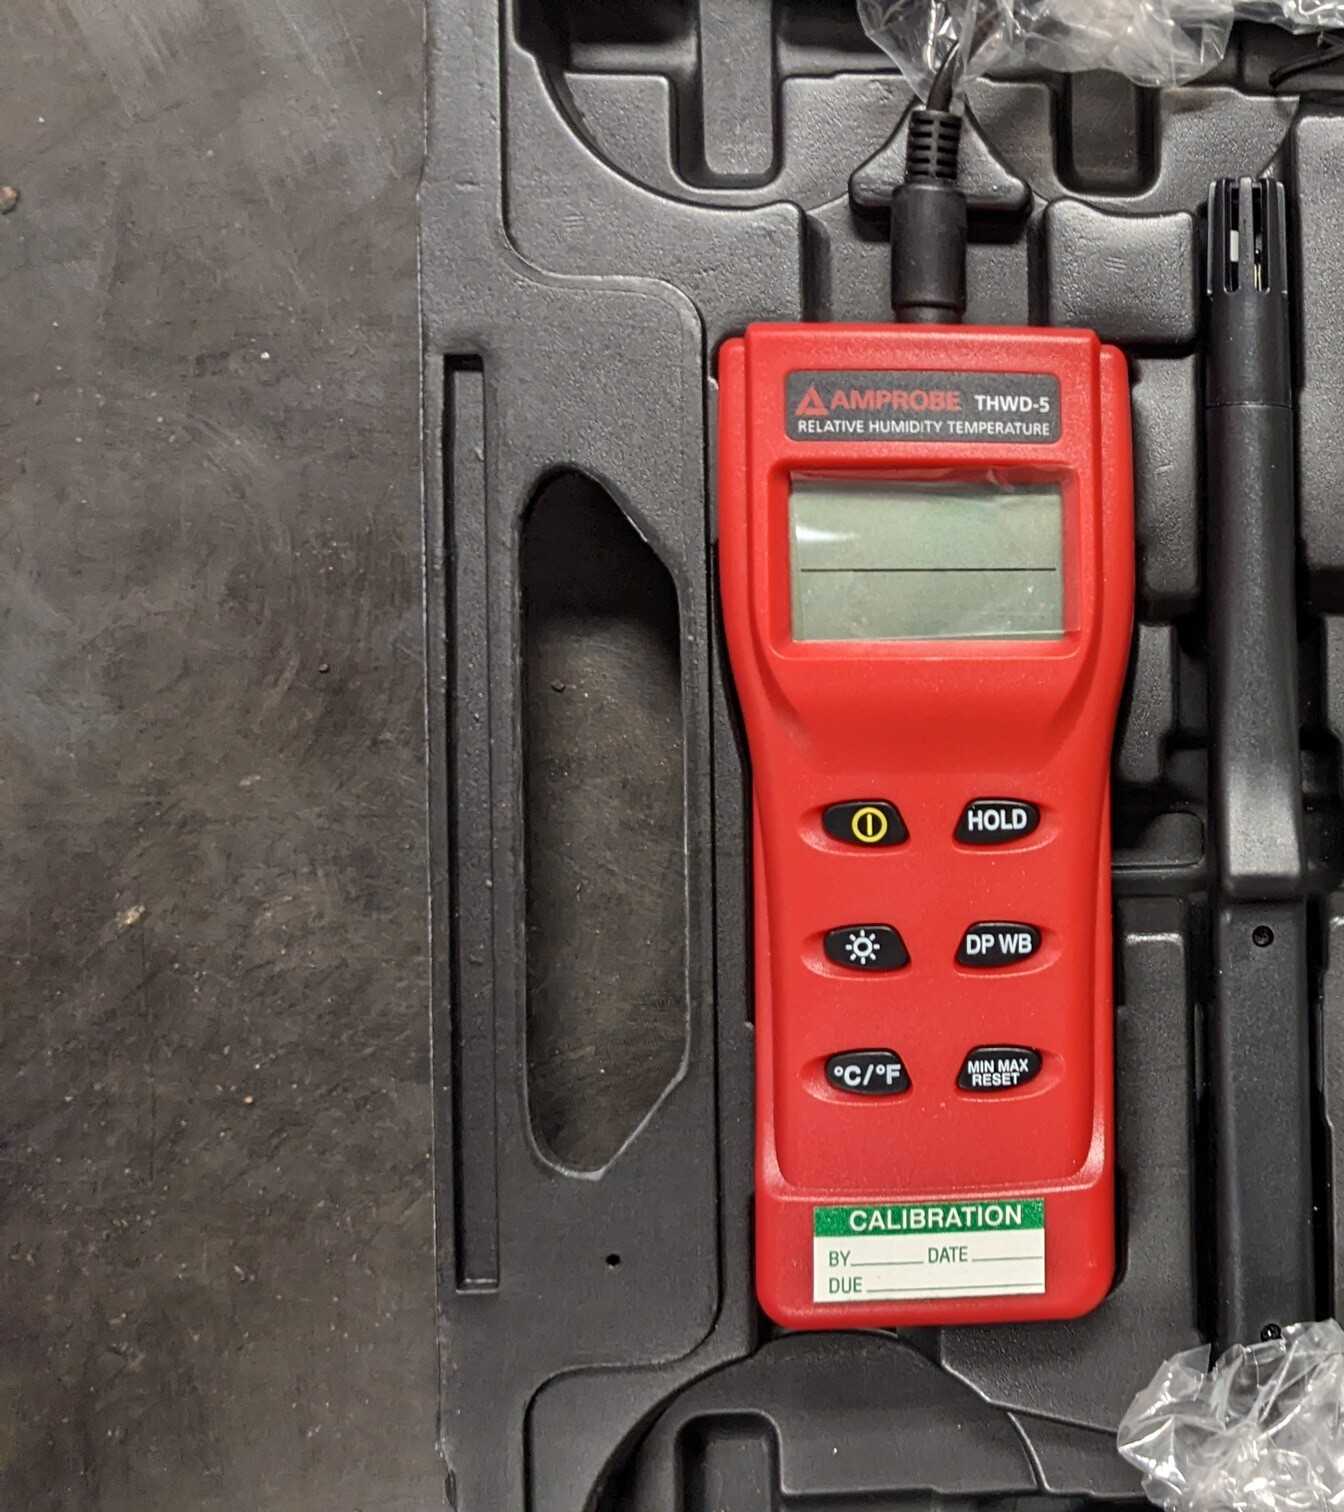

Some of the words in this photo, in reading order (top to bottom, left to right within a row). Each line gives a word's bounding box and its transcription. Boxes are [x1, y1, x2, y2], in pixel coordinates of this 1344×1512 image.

[831, 389, 961, 412] AMPROBE
[975, 394, 1051, 414] THWD-5
[798, 419, 865, 434] RELATIVE
[869, 420, 942, 434] HUMIDITY
[947, 421, 1050, 436] TEMPERATURE
[967, 808, 1027, 831] HOLD
[965, 934, 995, 955] DP
[998, 933, 1033, 952] WB
[967, 1060, 996, 1074] MIN
[998, 1058, 1029, 1073] MAX
[971, 1072, 1020, 1087] RESET
[849, 1204, 1022, 1232] CALIBRATION
[828, 1250, 850, 1267] BY
[927, 1246, 968, 1264] DATE
[828, 1276, 863, 1294] DUE
